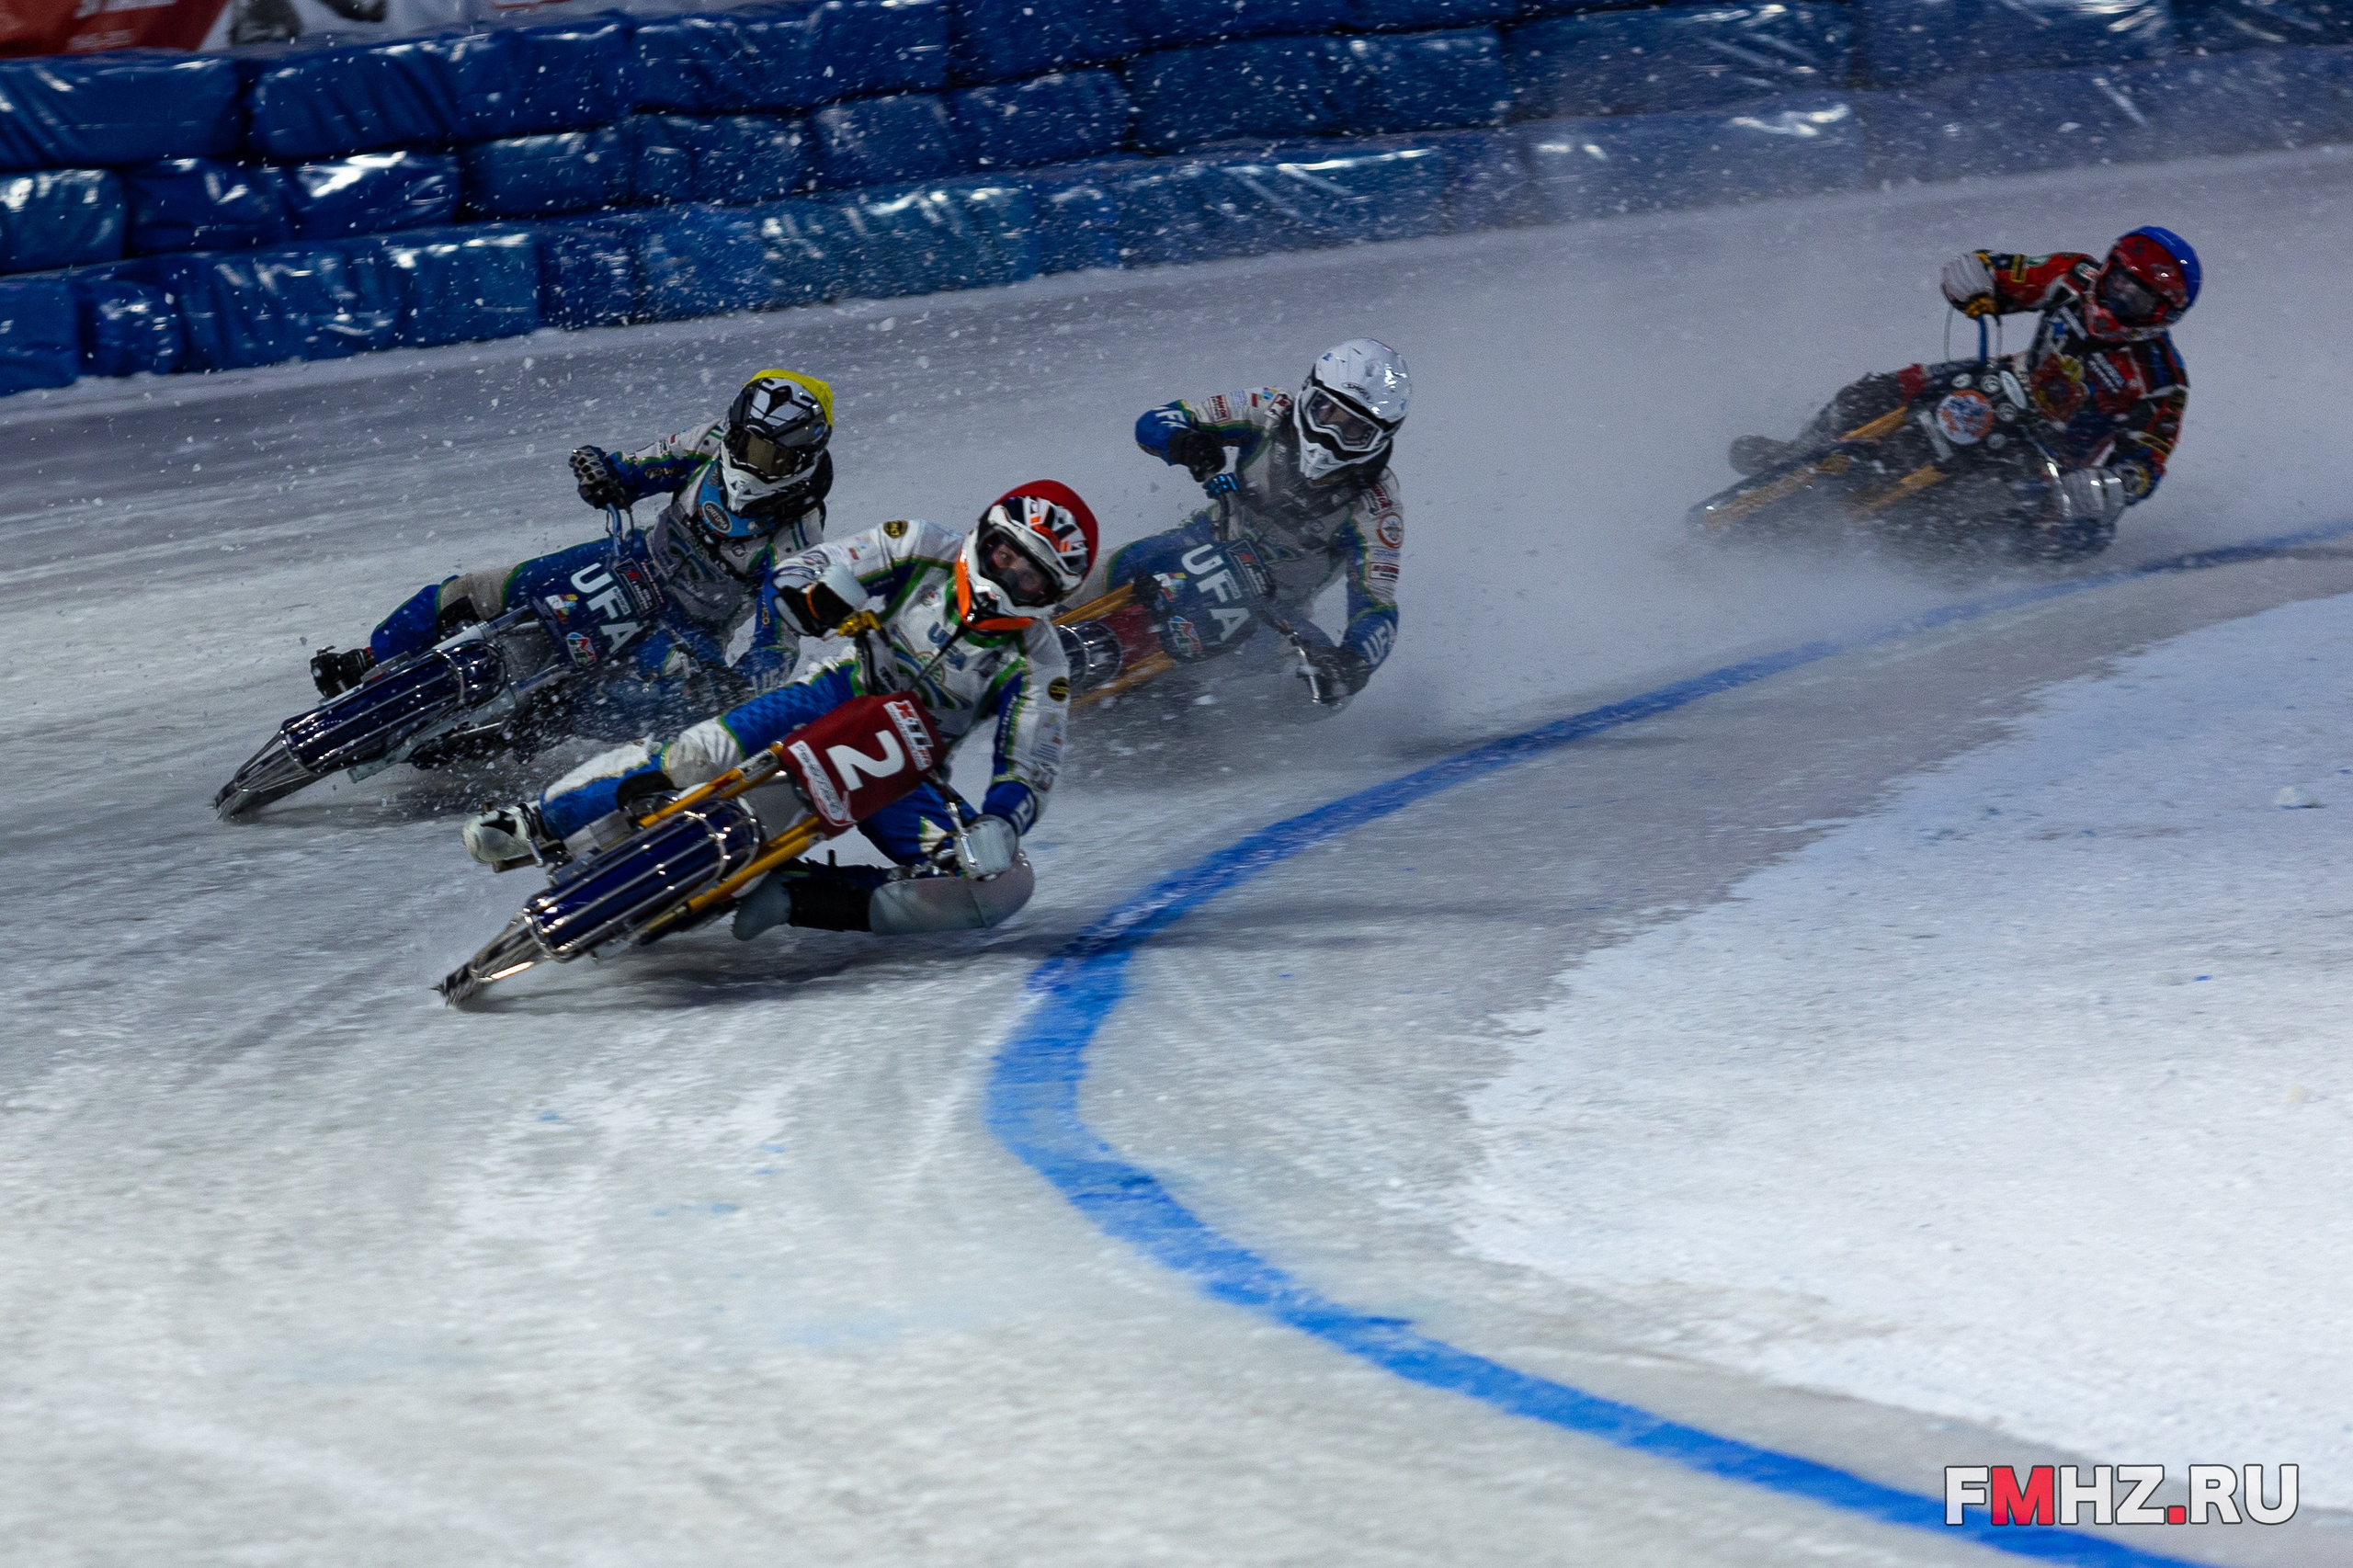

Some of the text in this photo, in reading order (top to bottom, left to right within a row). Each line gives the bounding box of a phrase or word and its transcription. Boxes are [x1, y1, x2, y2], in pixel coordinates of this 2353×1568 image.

[570, 562, 642, 654] UFA
[1181, 543, 1251, 642] UFA
[825, 729, 905, 791] 2
